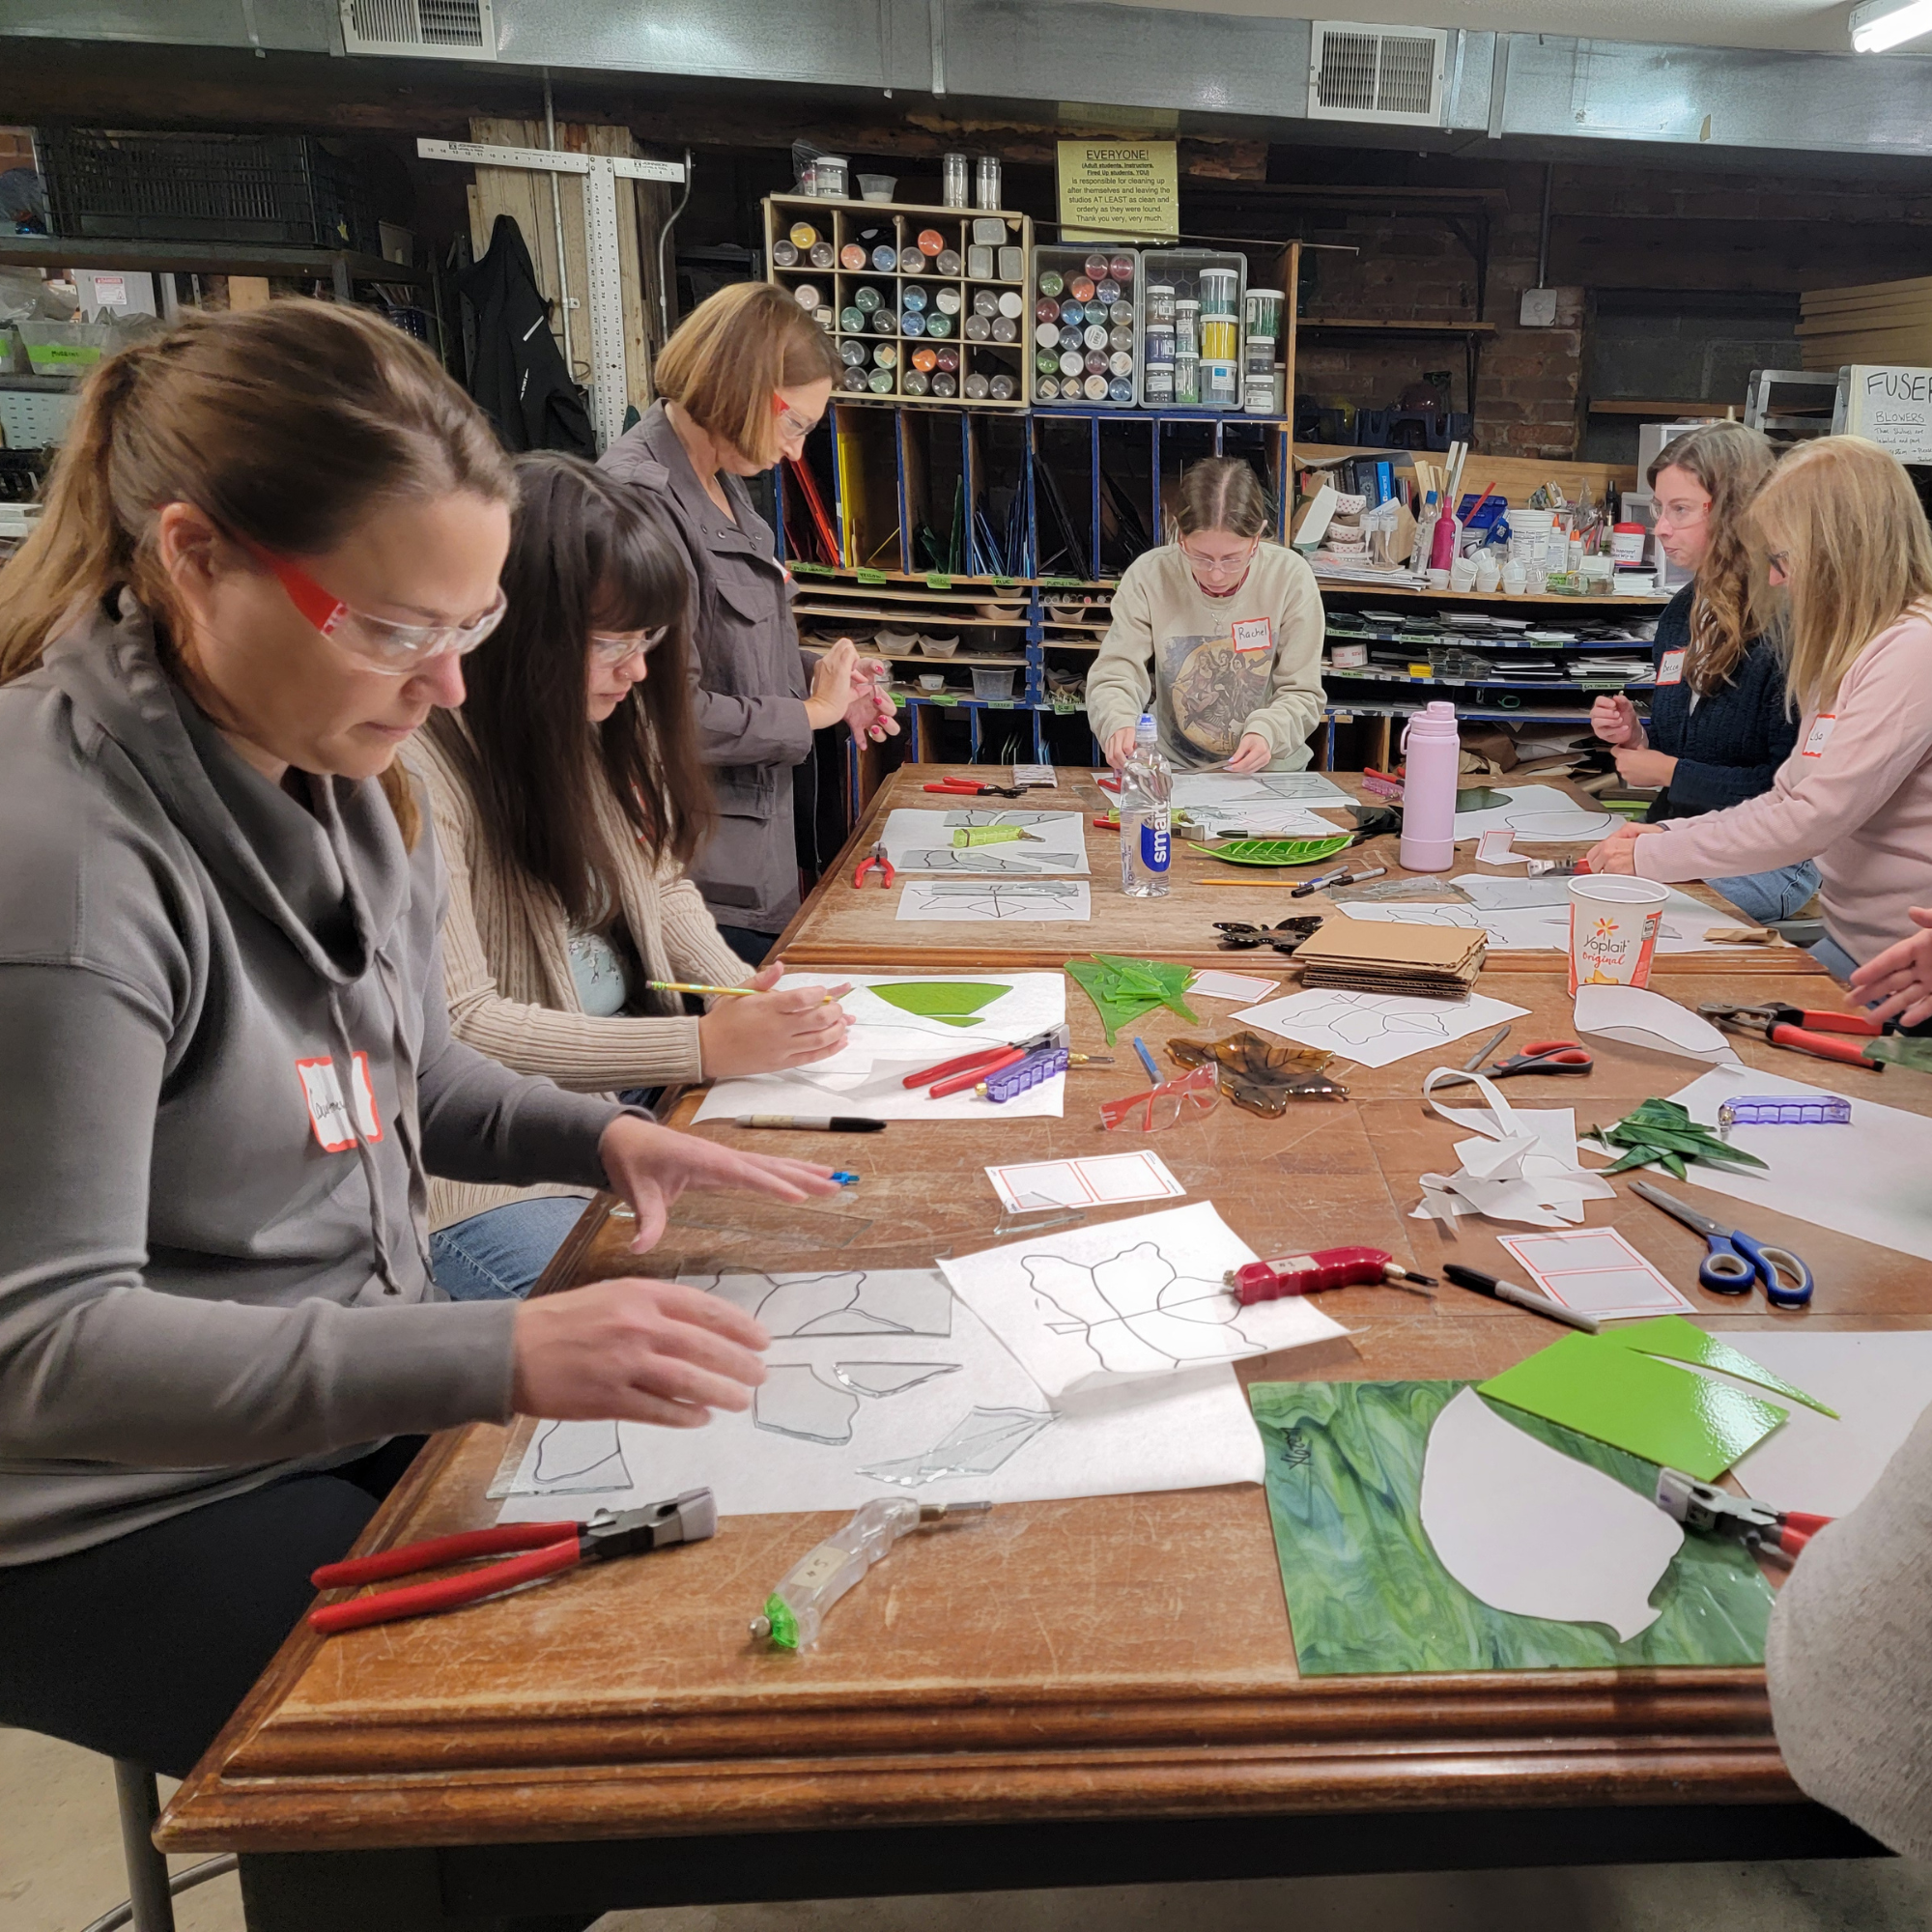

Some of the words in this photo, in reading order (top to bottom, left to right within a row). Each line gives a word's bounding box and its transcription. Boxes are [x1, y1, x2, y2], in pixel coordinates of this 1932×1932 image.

[1086, 149, 1150, 160] EVERYONE!
[1136, 187, 1158, 195] leaving
[1077, 206, 1098, 214] orderly
[1110, 206, 1123, 214] they
[1875, 411, 1925, 423] BLOWERS
[1238, 625, 1267, 640] Rachel
[1663, 660, 1679, 673] Becca
[1810, 731, 1823, 741] Lisa
[1153, 802, 1167, 863] smart
[1584, 935, 1627, 954] Yoplait
[1582, 952, 1625, 968] Original
